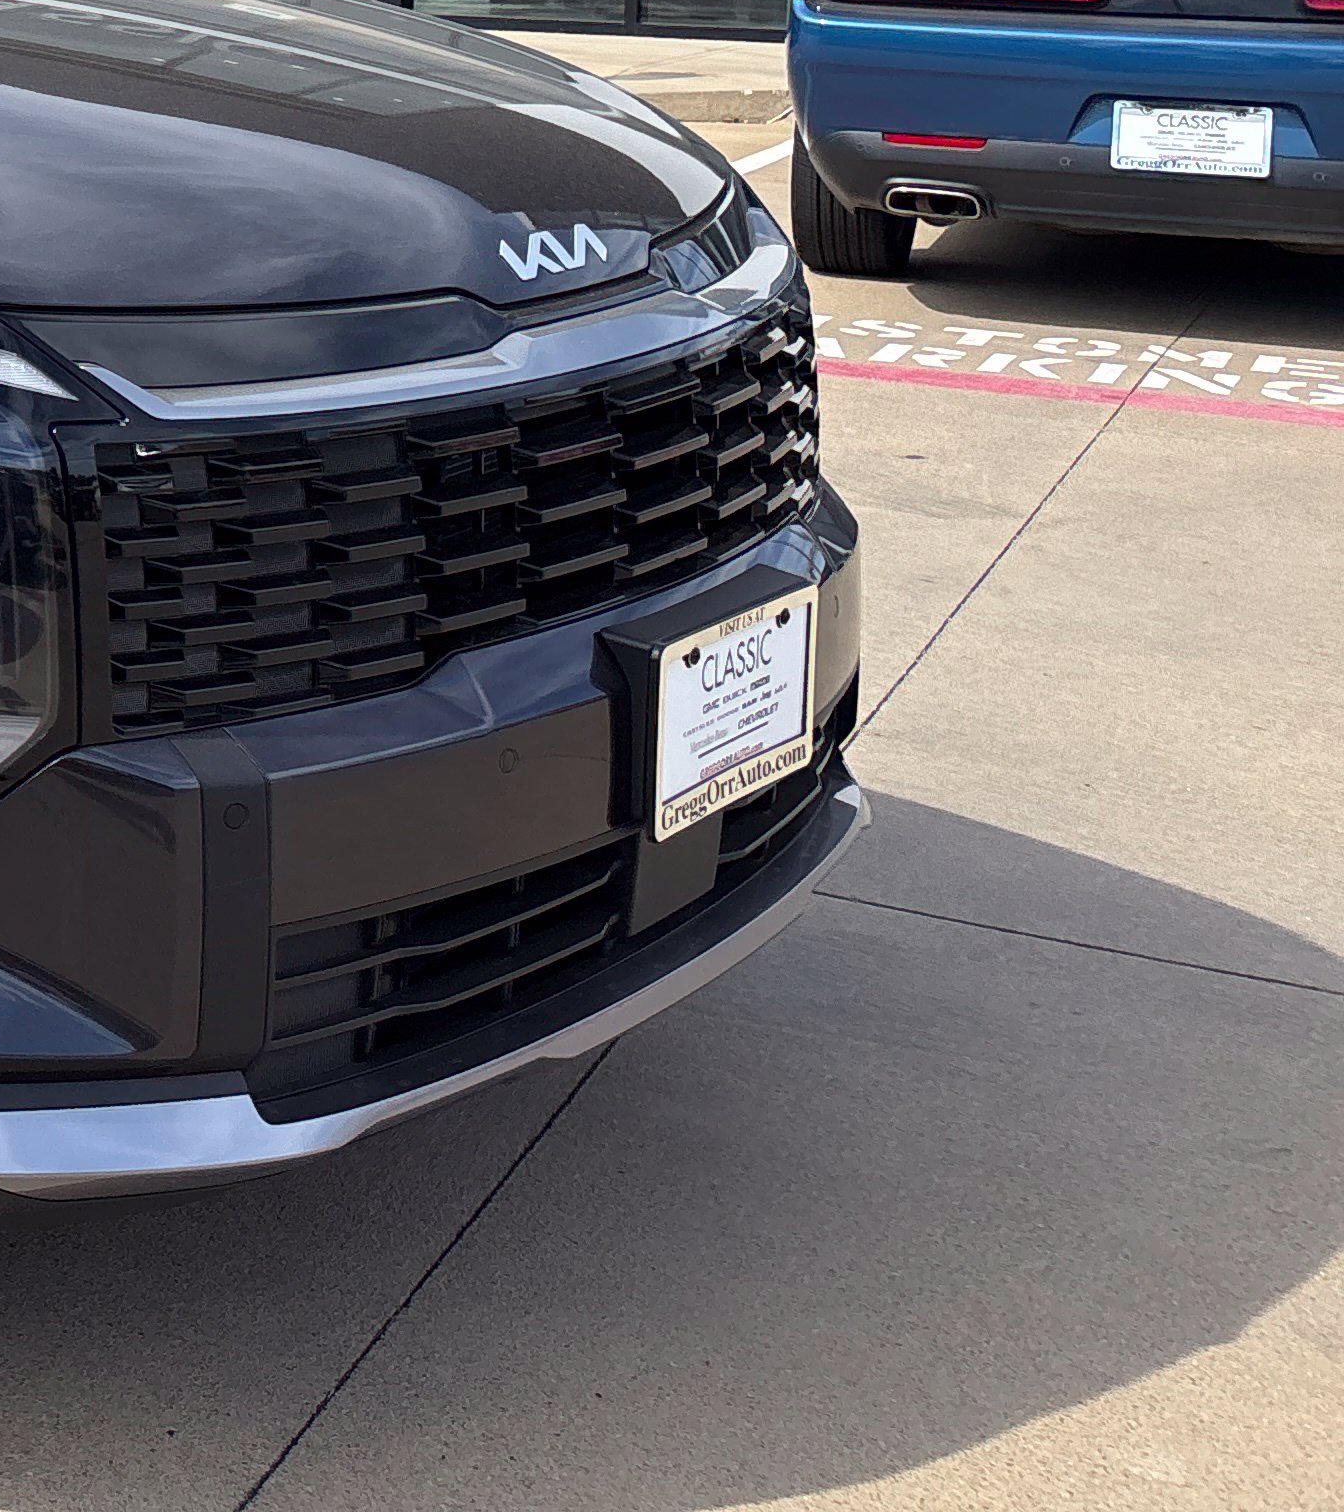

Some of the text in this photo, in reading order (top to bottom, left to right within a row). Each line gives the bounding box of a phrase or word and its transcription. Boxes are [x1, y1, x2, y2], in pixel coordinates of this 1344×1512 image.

[1157, 113, 1228, 131] CLASSIC
[499, 223, 608, 281] KIA
[812, 314, 1344, 381] STOME
[815, 337, 1344, 405] RKING
[702, 629, 772, 692] CLASSIC
[722, 688, 747, 704] BUICK
[737, 702, 779, 729] CHEVROLET
[661, 743, 807, 831] GreggOrrAuto.com
